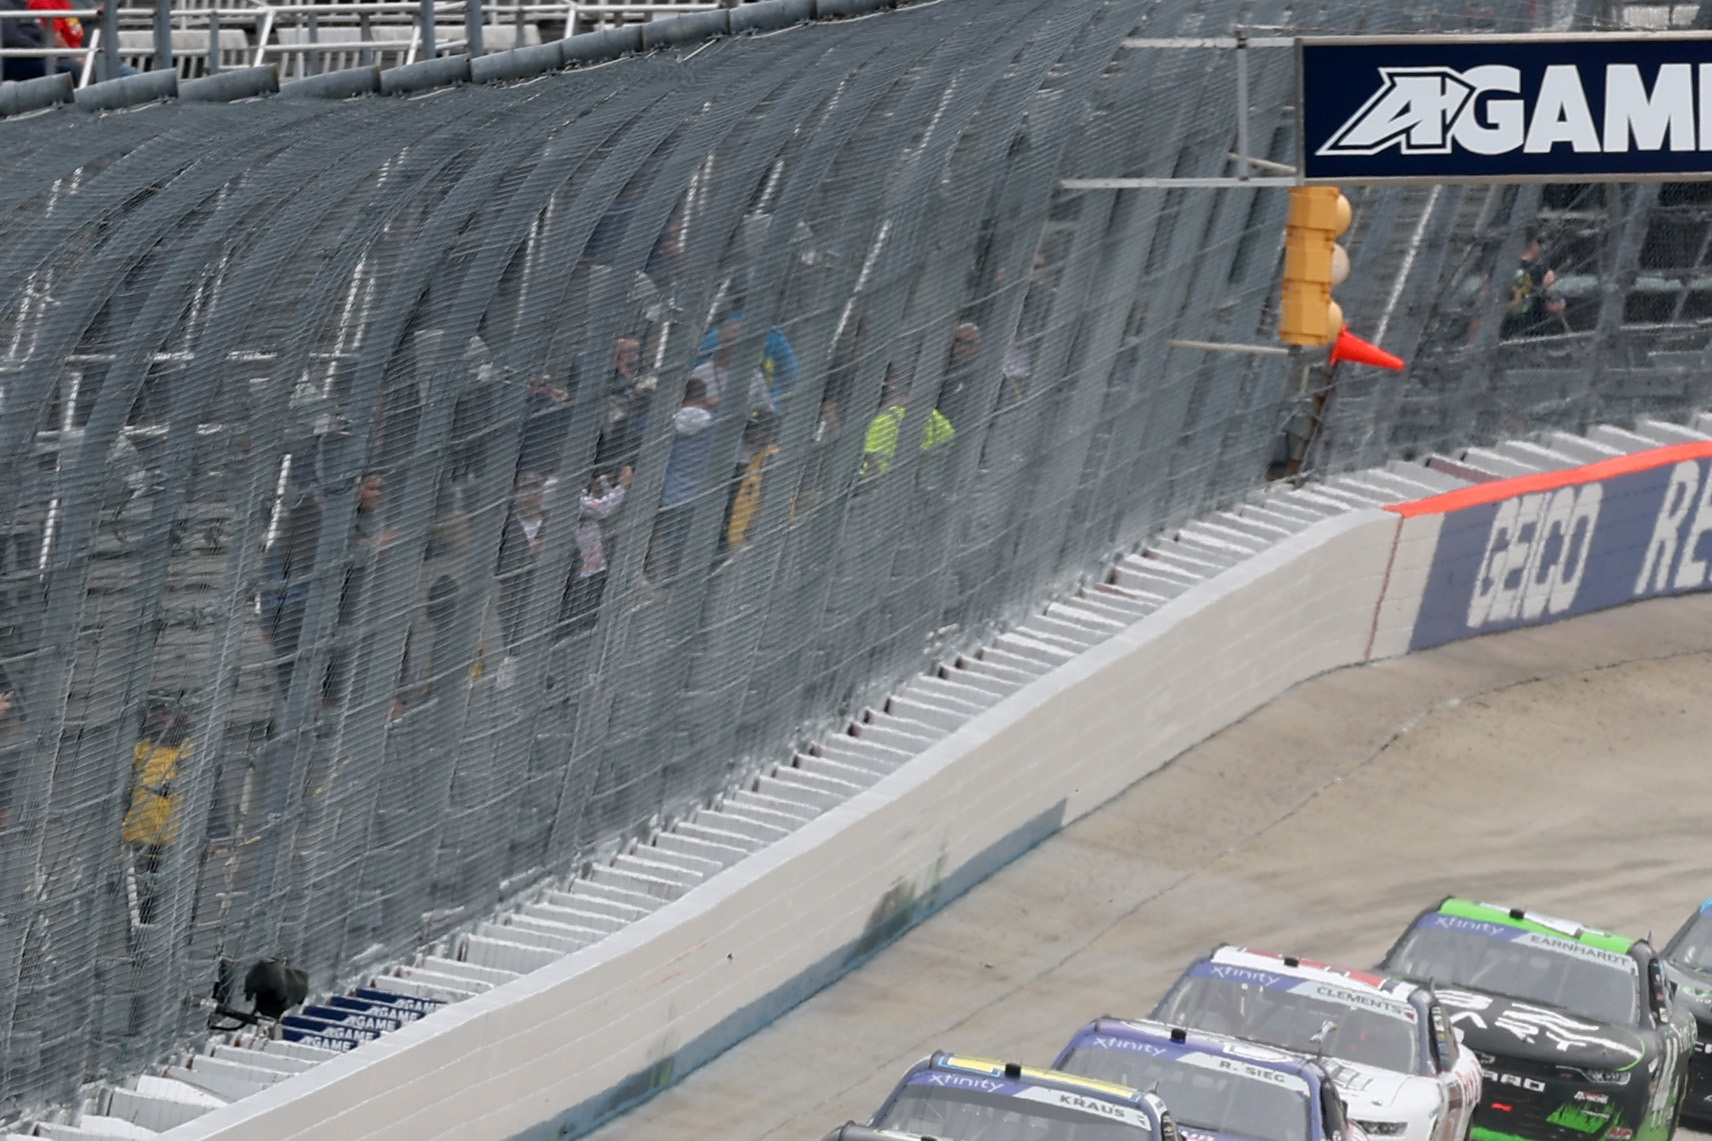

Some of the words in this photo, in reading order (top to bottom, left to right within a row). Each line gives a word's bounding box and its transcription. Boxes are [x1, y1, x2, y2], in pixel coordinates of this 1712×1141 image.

[1467, 483, 1604, 628] GEICO
[1209, 963, 1281, 986] xfinity
[1314, 985, 1403, 1015] CLEMENTS
[1092, 1035, 1167, 1058] xfinity
[1244, 1063, 1287, 1084] SIEG
[928, 1071, 1005, 1094] xfinity
[1058, 1093, 1127, 1119] KRAUS
